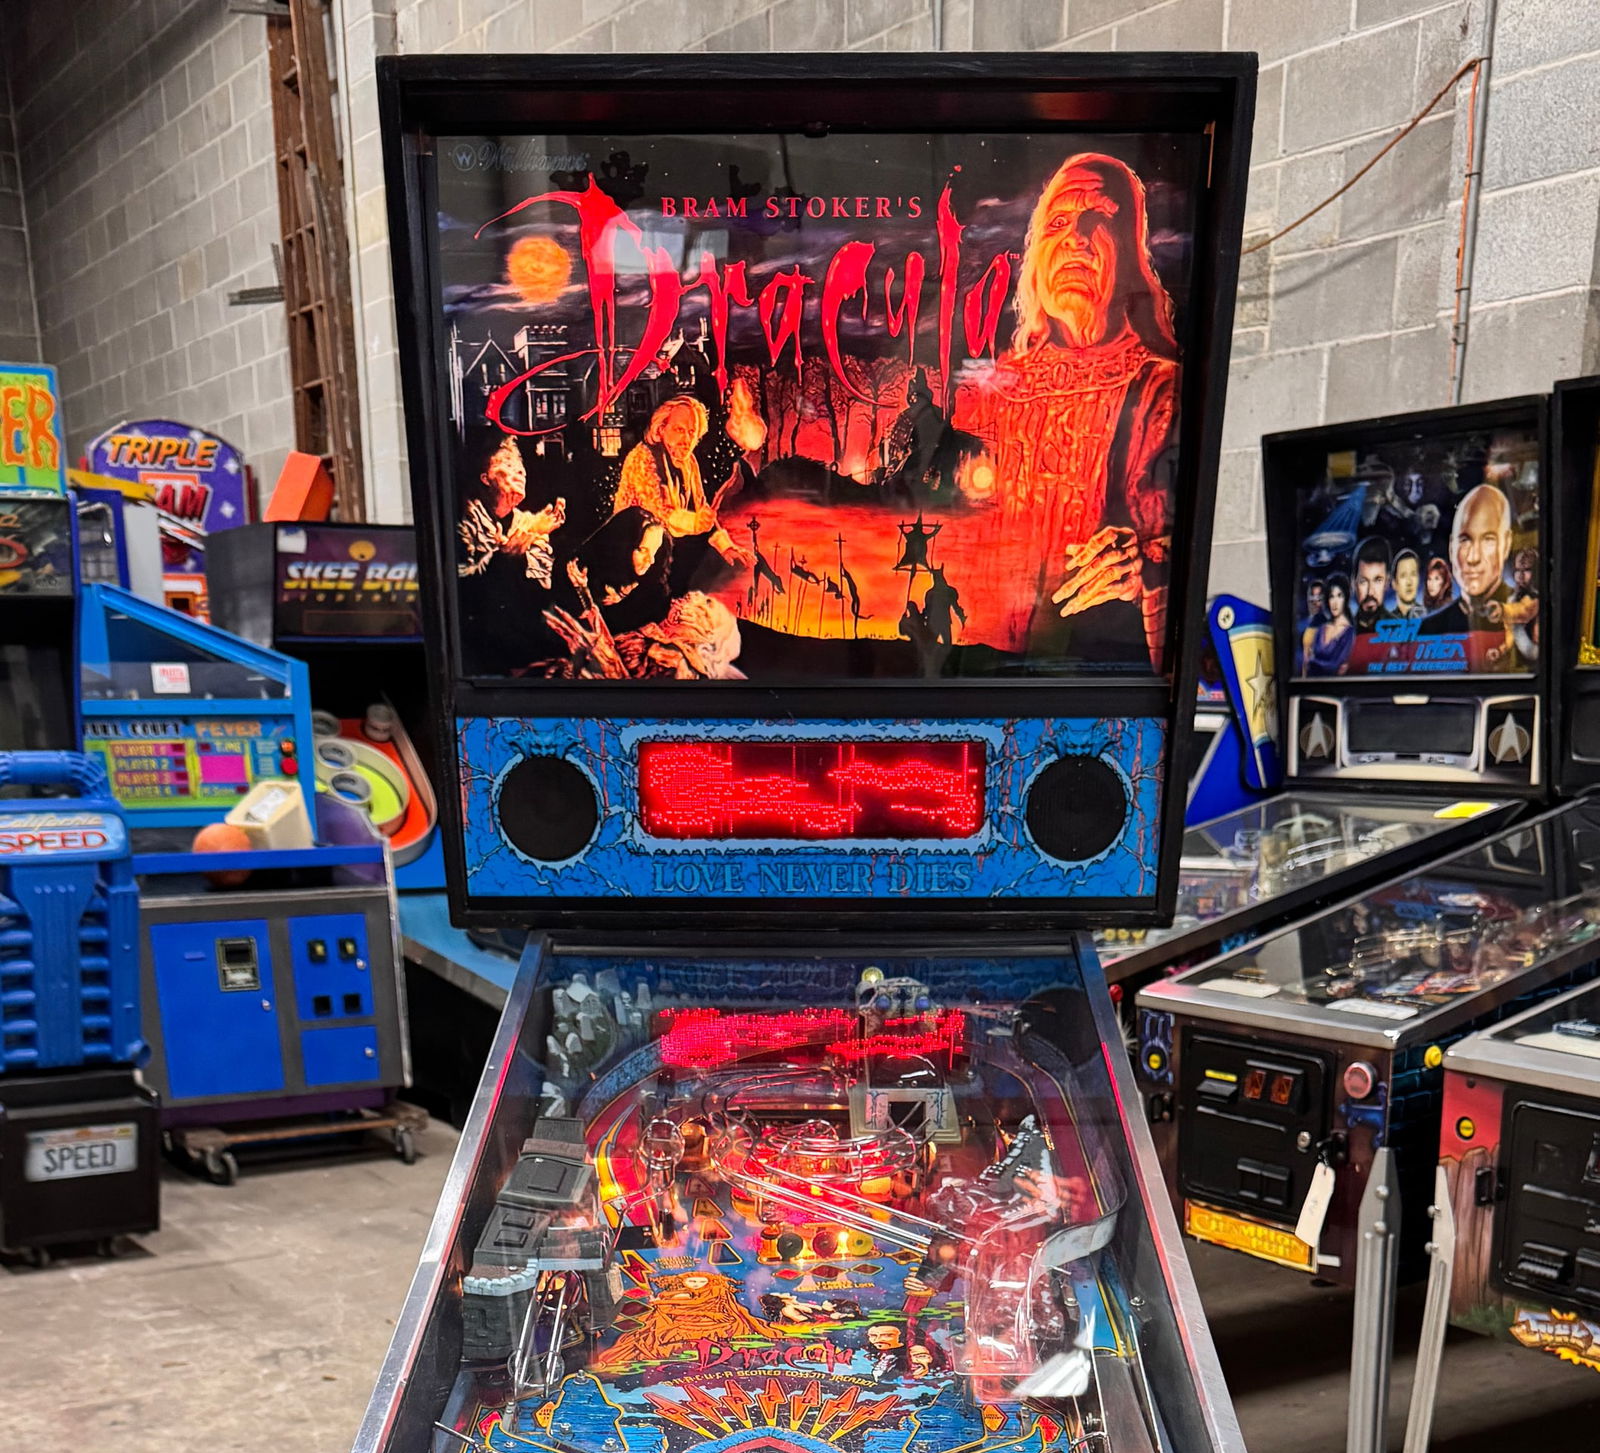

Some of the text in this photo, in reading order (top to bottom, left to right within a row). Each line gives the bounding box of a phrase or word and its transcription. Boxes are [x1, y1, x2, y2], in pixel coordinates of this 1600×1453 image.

[661, 196, 922, 218] BRAM STOKER'S
[474, 166, 1011, 437] Dracula
[106, 435, 219, 468] TRIPLE
[283, 560, 360, 590] SKEE
[196, 720, 262, 736] FEVER
[0, 830, 107, 854] SPEED
[653, 861, 974, 893] LOVE NEVER DIES
[43, 1142, 117, 1174] SPEED
[657, 1338, 853, 1372] Dracula
